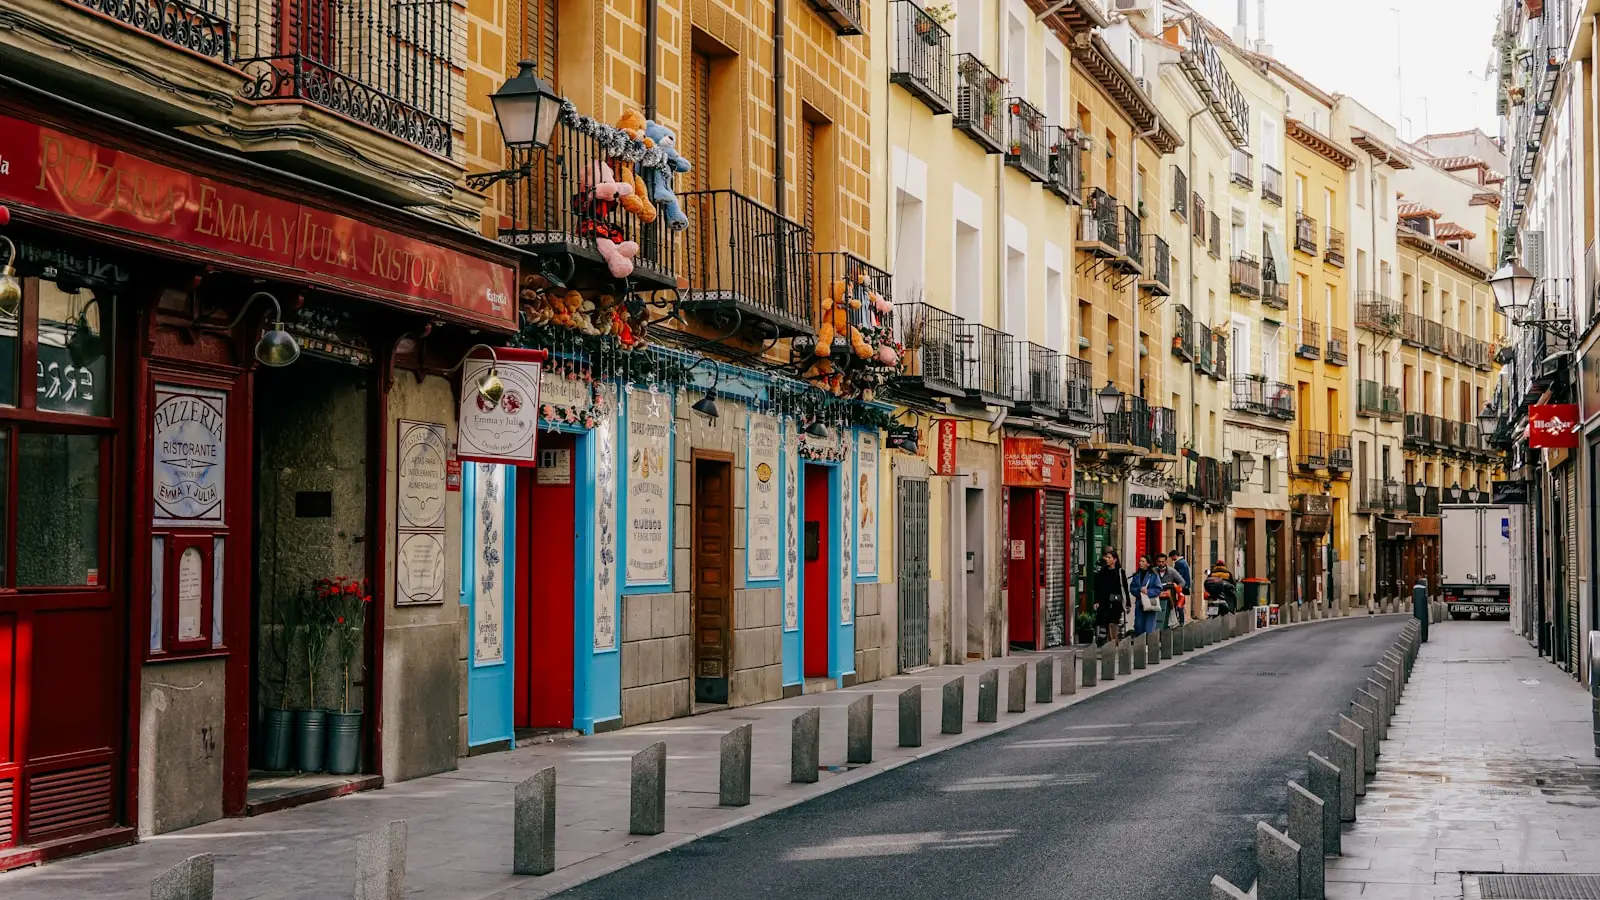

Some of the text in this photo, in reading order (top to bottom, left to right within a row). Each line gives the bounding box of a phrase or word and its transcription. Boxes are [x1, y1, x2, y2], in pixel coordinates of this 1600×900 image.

[35, 136, 465, 300] PIZZERIA EMMA Y JULIA RISTORAN
[154, 400, 224, 442] PIZZERIA
[473, 415, 525, 428] Emma y Juli
[163, 441, 217, 457] RISTORANTE
[159, 484, 217, 502] EMMA Y JULIA
